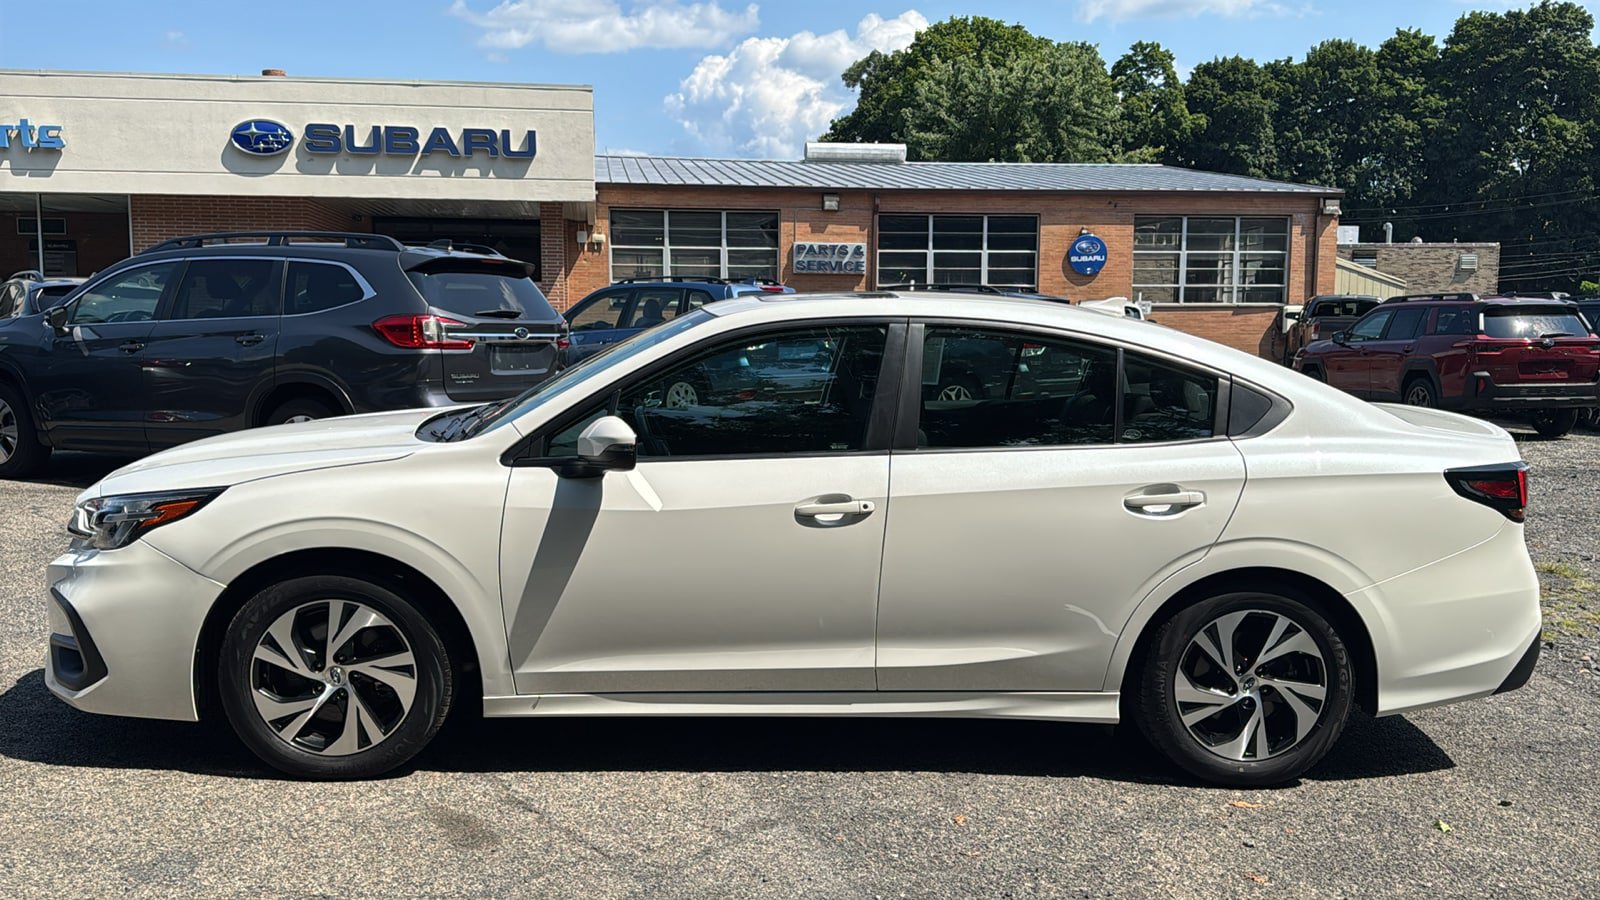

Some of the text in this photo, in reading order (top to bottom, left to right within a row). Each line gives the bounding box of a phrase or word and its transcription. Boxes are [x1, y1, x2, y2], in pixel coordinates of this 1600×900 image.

[304, 123, 537, 159] SUBARU
[795, 244, 864, 256] PARTS &
[795, 260, 865, 272] SERVICE
